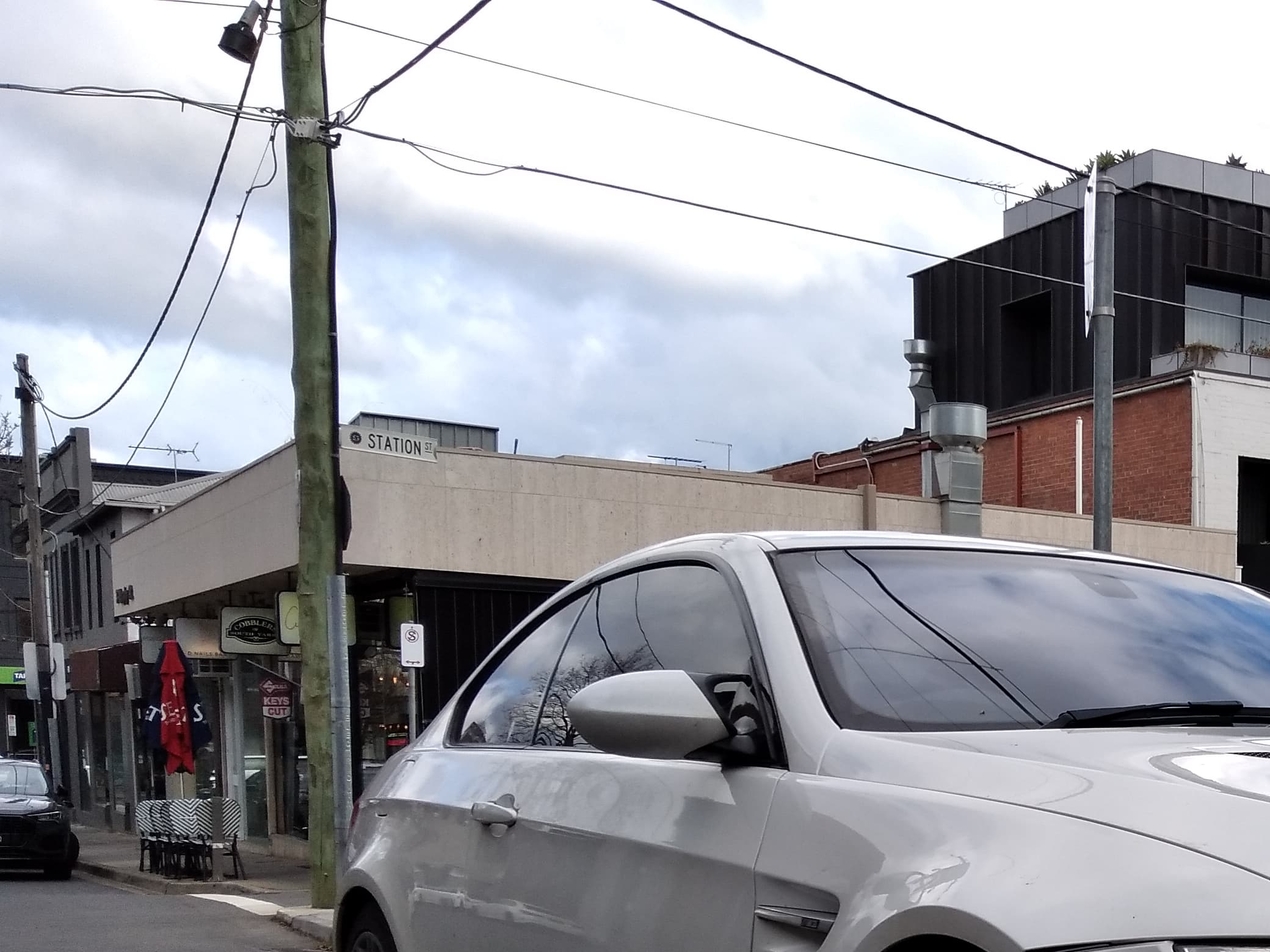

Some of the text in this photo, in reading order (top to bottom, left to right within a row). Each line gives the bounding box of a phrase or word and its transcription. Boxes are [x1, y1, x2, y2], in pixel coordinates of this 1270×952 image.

[368, 434, 433, 455] STATION ST
[263, 696, 290, 705] KEYS
[267, 707, 287, 715] CUT
